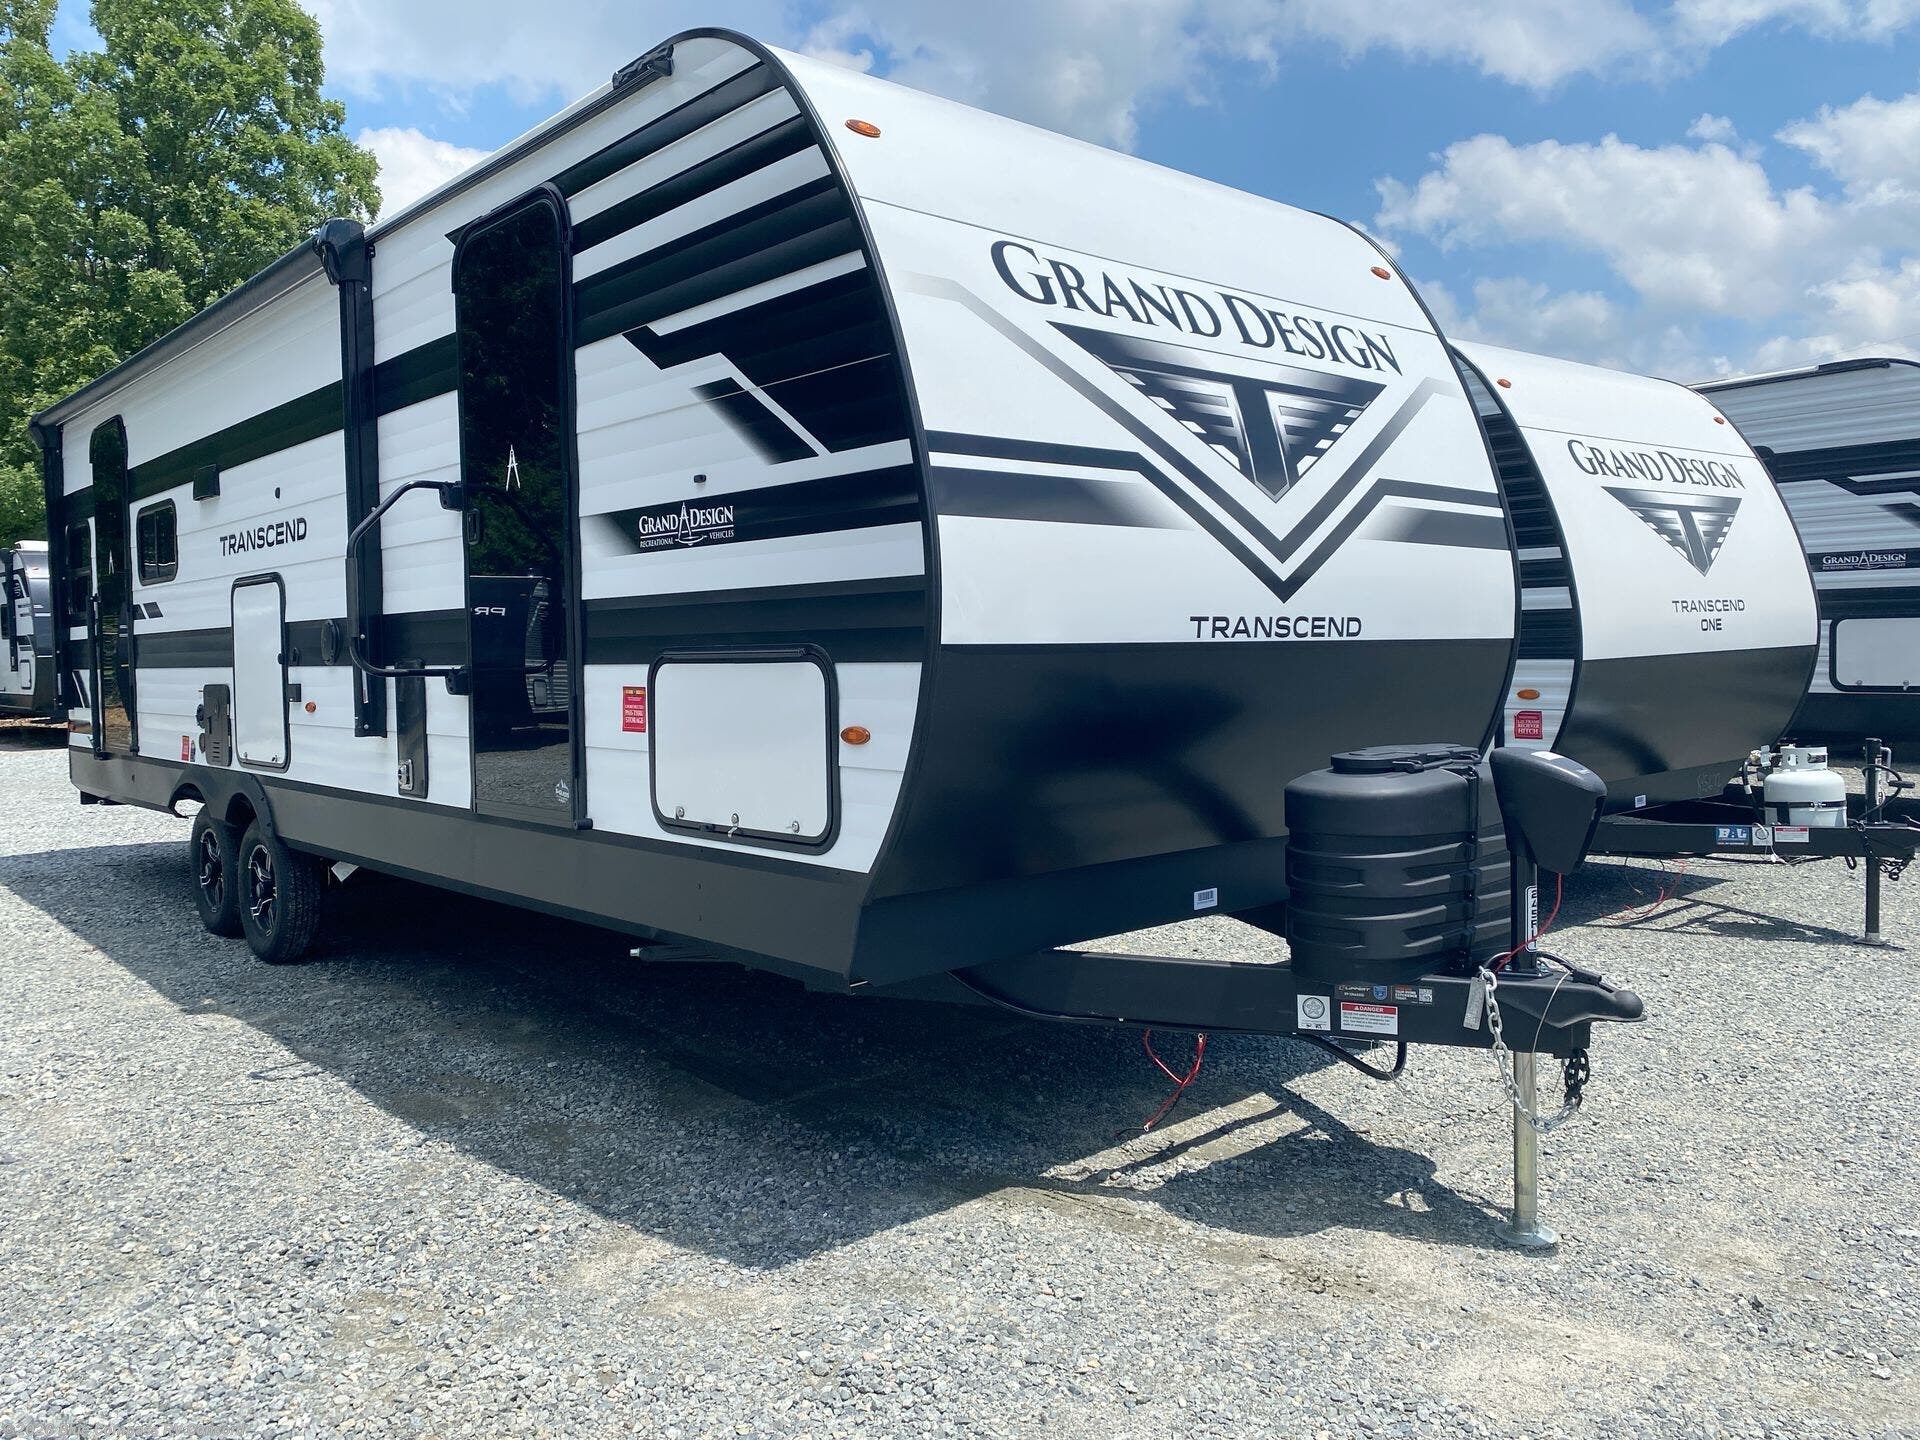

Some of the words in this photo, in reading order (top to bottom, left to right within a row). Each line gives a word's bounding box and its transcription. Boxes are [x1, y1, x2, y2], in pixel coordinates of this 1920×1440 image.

[990, 240, 1222, 337] GRAND
[1214, 291, 1402, 376] DESIGN
[1567, 439, 1664, 482] GRAND
[1654, 450, 1746, 489] DESIGN
[638, 514, 679, 534] GRAND
[689, 505, 734, 528] DESIGN
[219, 517, 307, 557] TRANSCEND
[640, 537, 674, 548] RECREATIONAL
[709, 529, 735, 540] VEHICLES
[1822, 555, 1859, 565] GRAND
[1869, 553, 1906, 562] DESIGN
[1671, 599, 1746, 613] TRANSCEND
[1190, 616, 1362, 639] TRANSCEND
[1700, 618, 1723, 632] ONE
